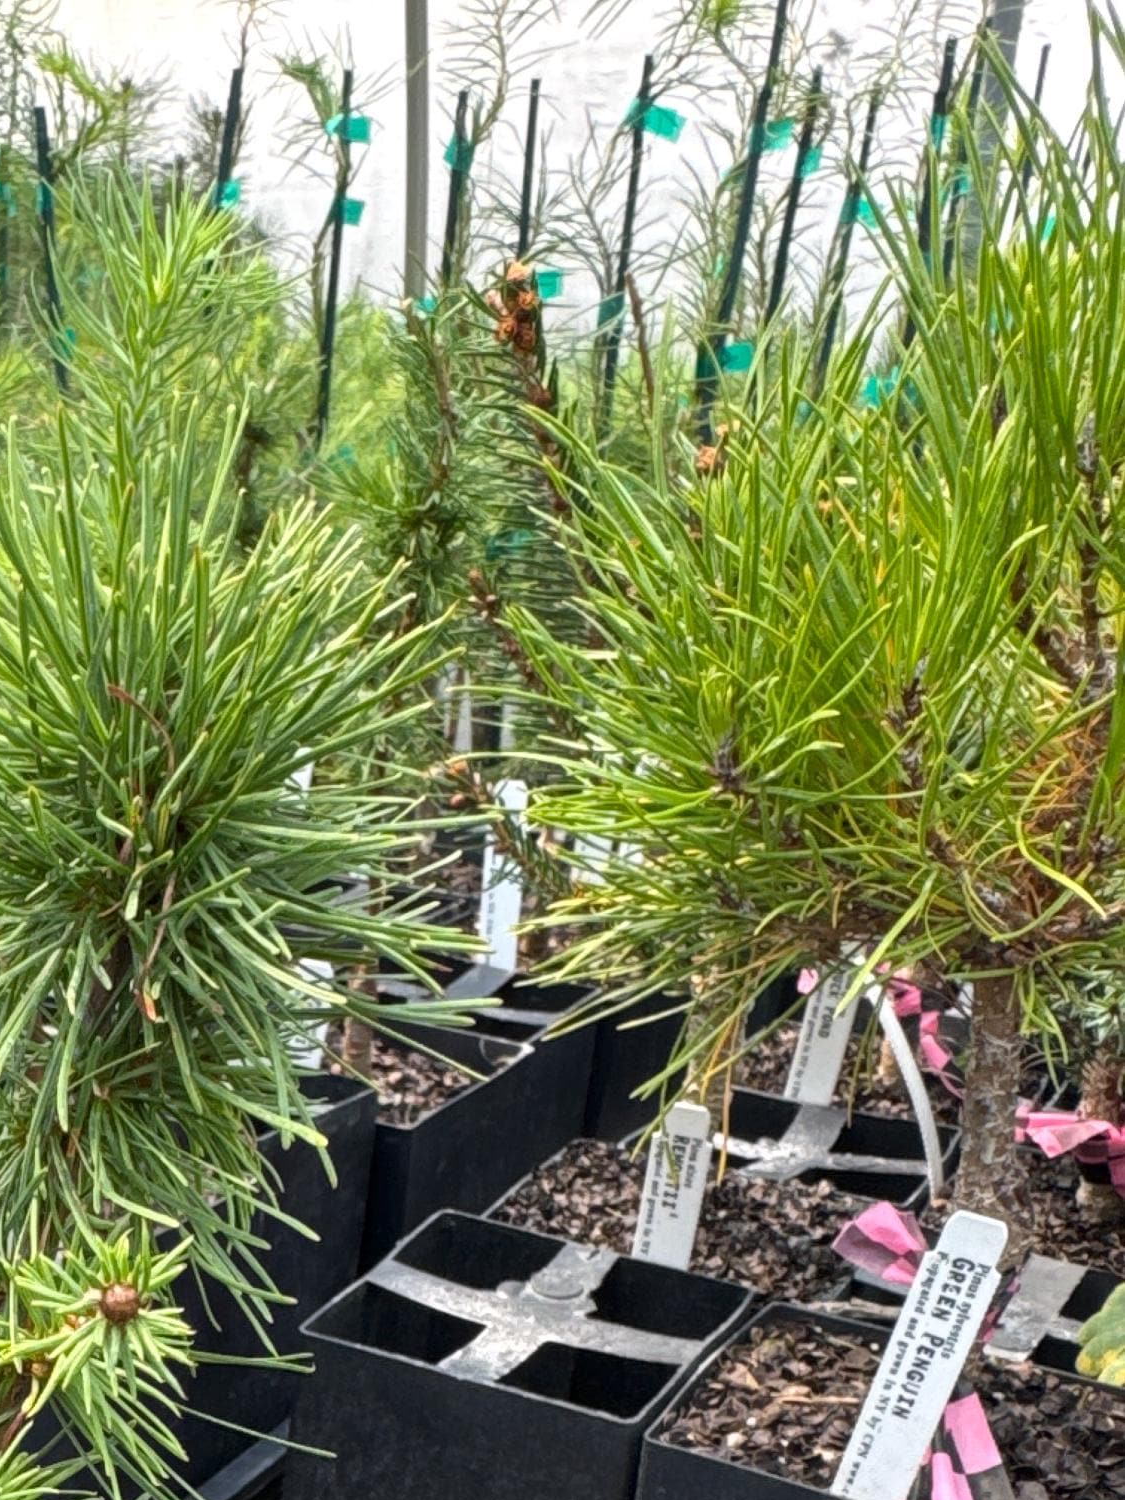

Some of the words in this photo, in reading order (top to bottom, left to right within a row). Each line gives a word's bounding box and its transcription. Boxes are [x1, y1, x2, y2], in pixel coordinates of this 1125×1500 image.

[917, 1251, 948, 1314] Popagated
[931, 1258, 976, 1321] GREEN
[966, 1263, 992, 1299] Pinus
[905, 1317, 918, 1339] and
[941, 1302, 971, 1359] sylvestris
[889, 1341, 908, 1375] grown
[892, 1331, 944, 1419] PENGUIN
[875, 1395, 890, 1414] NY
[866, 1416, 882, 1431] by
